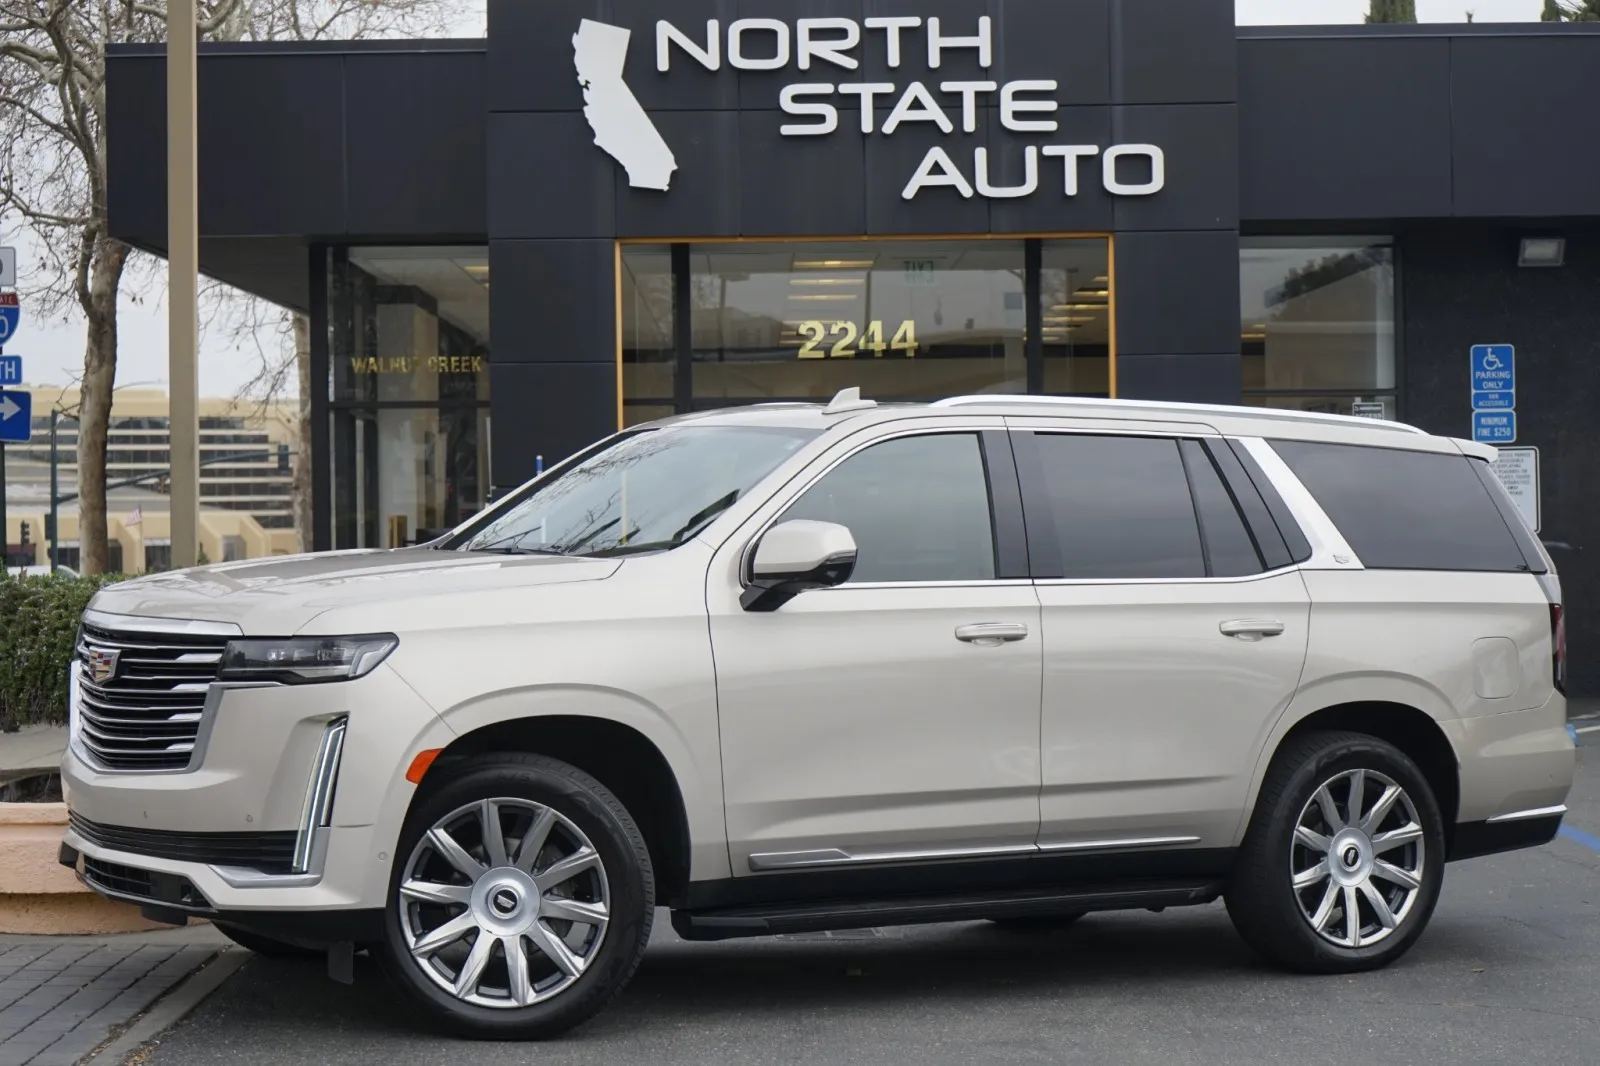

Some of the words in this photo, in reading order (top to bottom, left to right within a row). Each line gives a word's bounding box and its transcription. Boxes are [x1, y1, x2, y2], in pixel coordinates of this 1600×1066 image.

[655, 15, 992, 72] NORTH
[779, 79, 1059, 136] STATE
[901, 143, 1165, 200] AUTO
[797, 319, 919, 359] 2244
[427, 355, 482, 373] CREEK
[1475, 370, 1511, 380] PARKING
[1482, 380, 1504, 389] ONLY
[1477, 427, 1492, 436] FINE
[1494, 427, 1512, 437] $250
